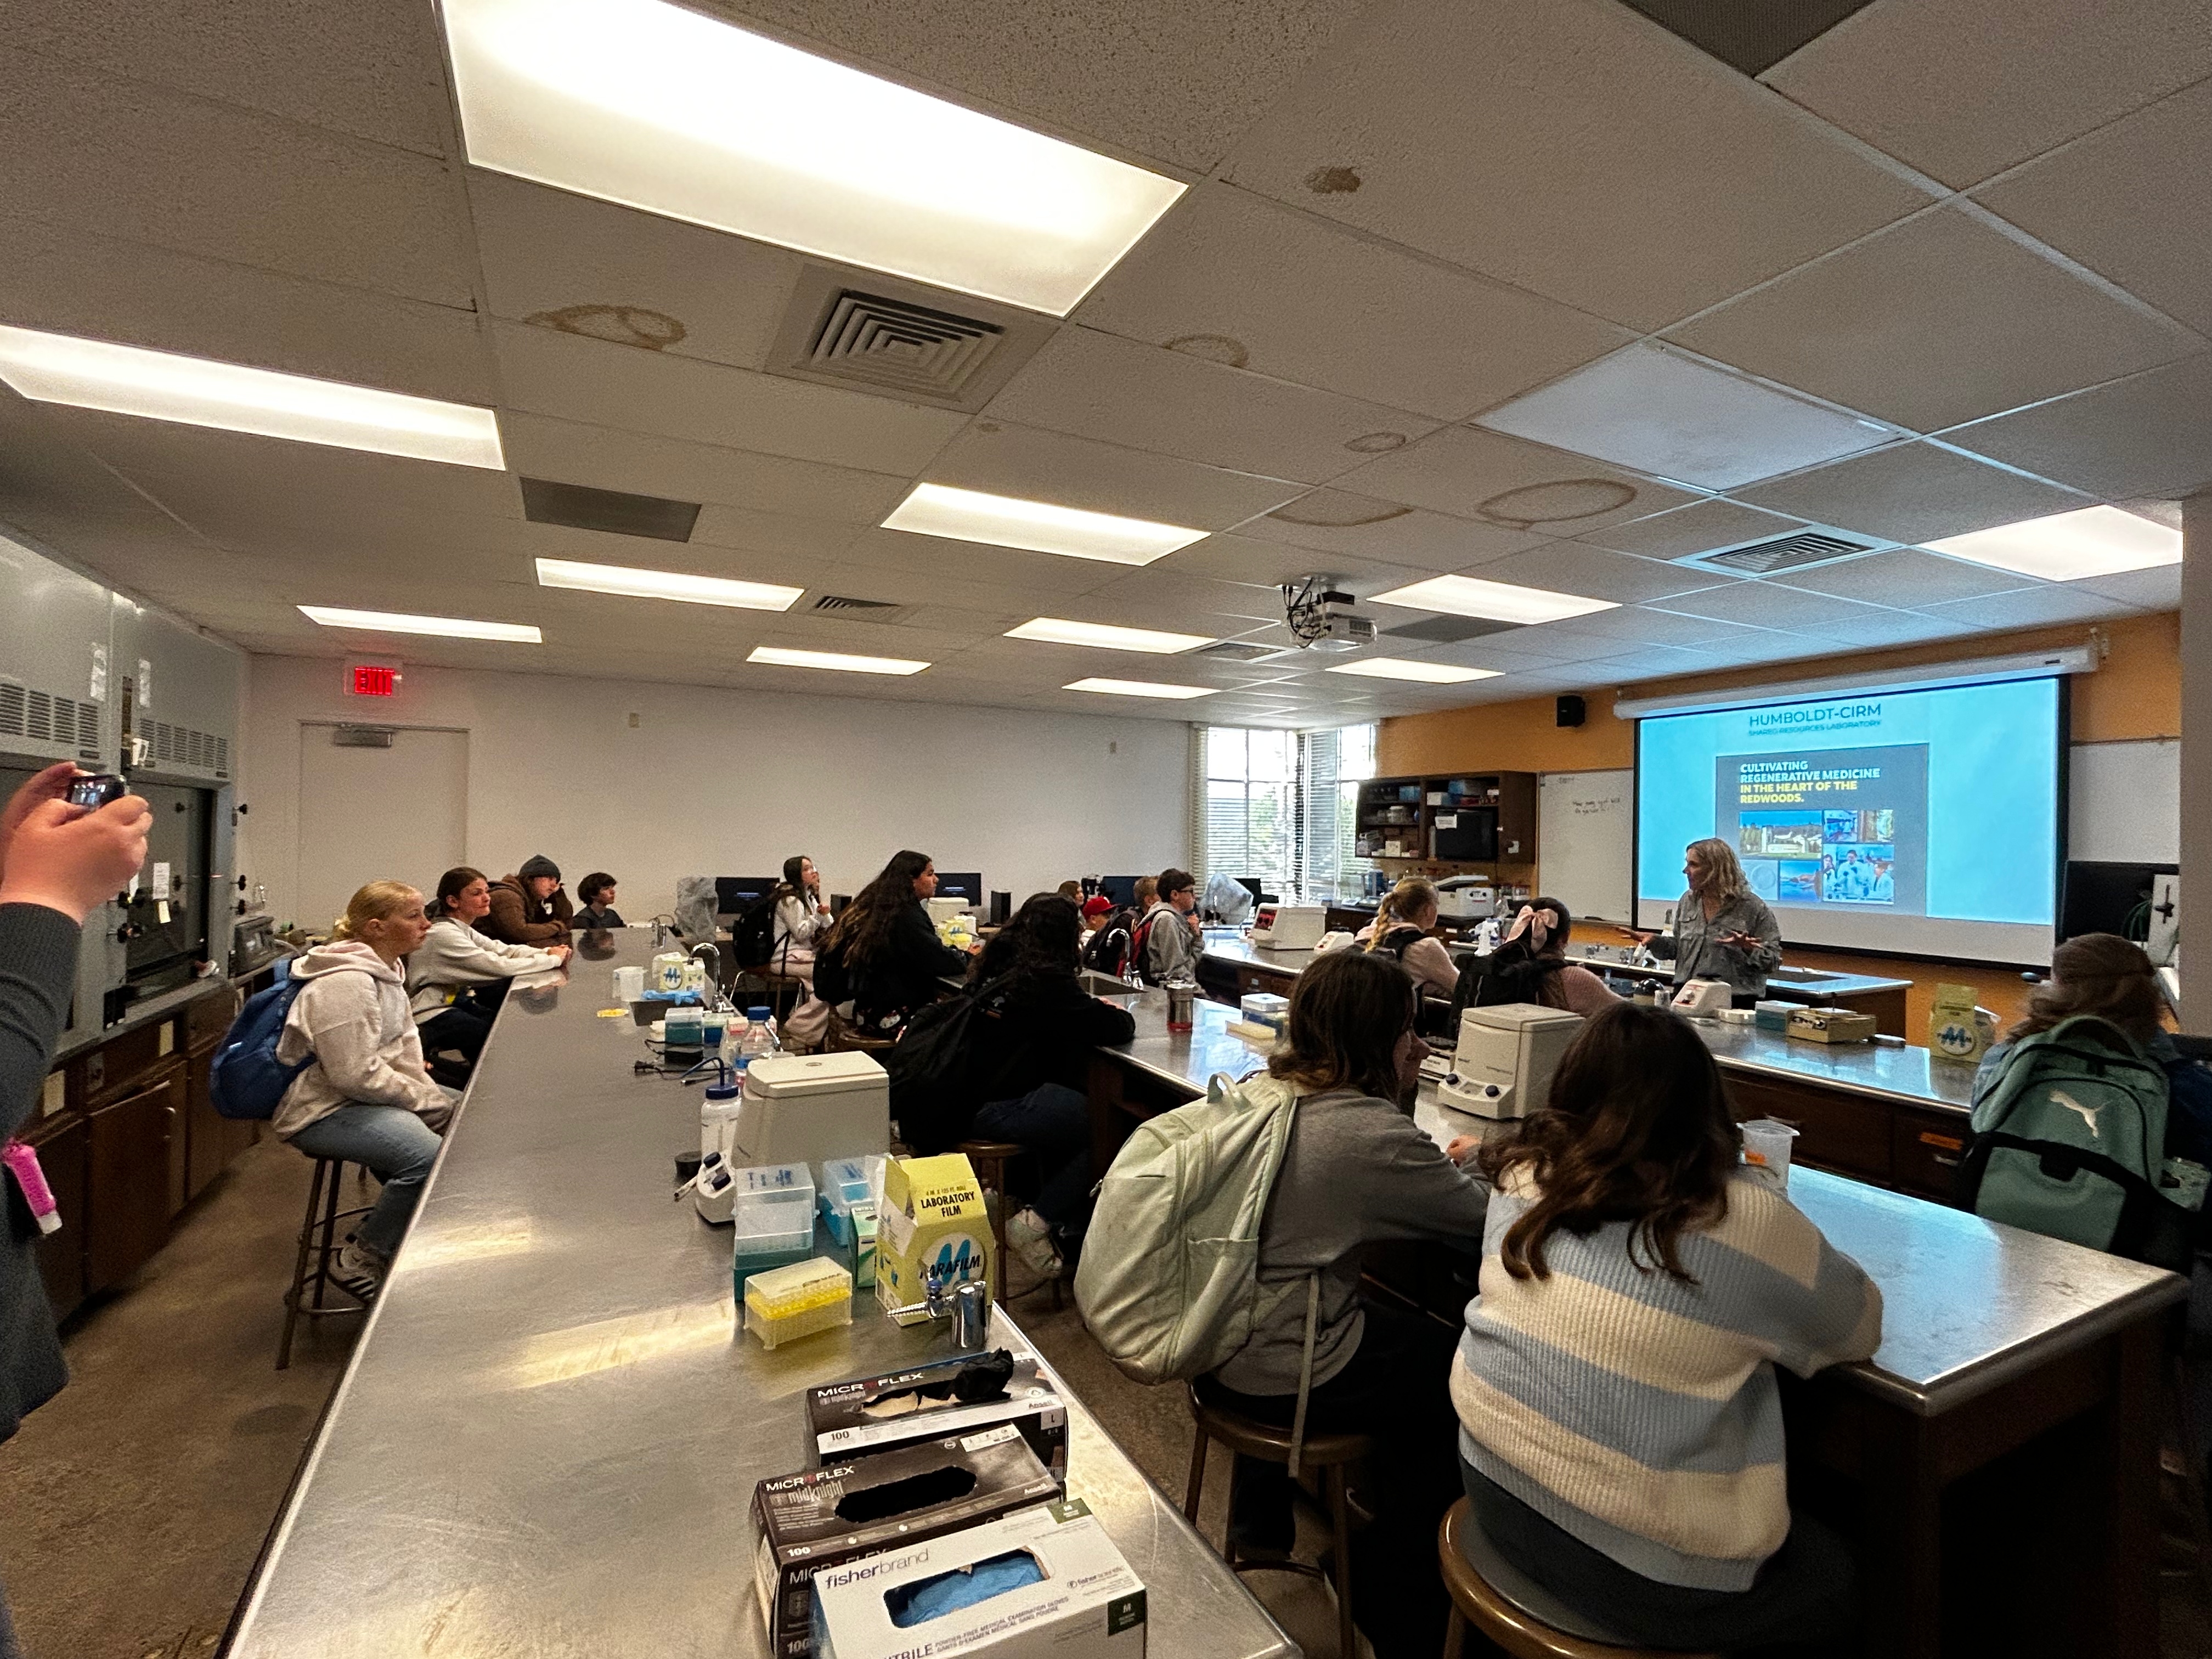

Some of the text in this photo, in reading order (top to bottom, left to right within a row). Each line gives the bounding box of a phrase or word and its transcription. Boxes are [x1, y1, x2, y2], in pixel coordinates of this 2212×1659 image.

[355, 668, 394, 696] EXIT
[1750, 703, 1881, 726] HUMBOLDT-CIRM
[1779, 725, 1825, 734] RESOURCES
[1826, 719, 1882, 731] LABORATORY
[1740, 760, 1808, 773] CULTIVATING
[1740, 768, 1880, 783] REGENERATIVE MEDICINE
[1740, 781, 1857, 793] IN THE HEART OF THE
[1740, 793, 1804, 804] REDWOODS.
[921, 1191, 974, 1209] LABORATORY
[941, 1205, 961, 1217] FILM
[817, 1373, 924, 1398] MICROFLEX
[831, 1431, 849, 1441] 100
[766, 1465, 855, 1491] MICROFLEX
[788, 1480, 844, 1504] midknight
[787, 1547, 811, 1557] 100
[826, 1548, 929, 1589] fisherbrand
[1047, 1596, 1069, 1608] GLOVES
[1123, 1603, 1131, 1613] M
